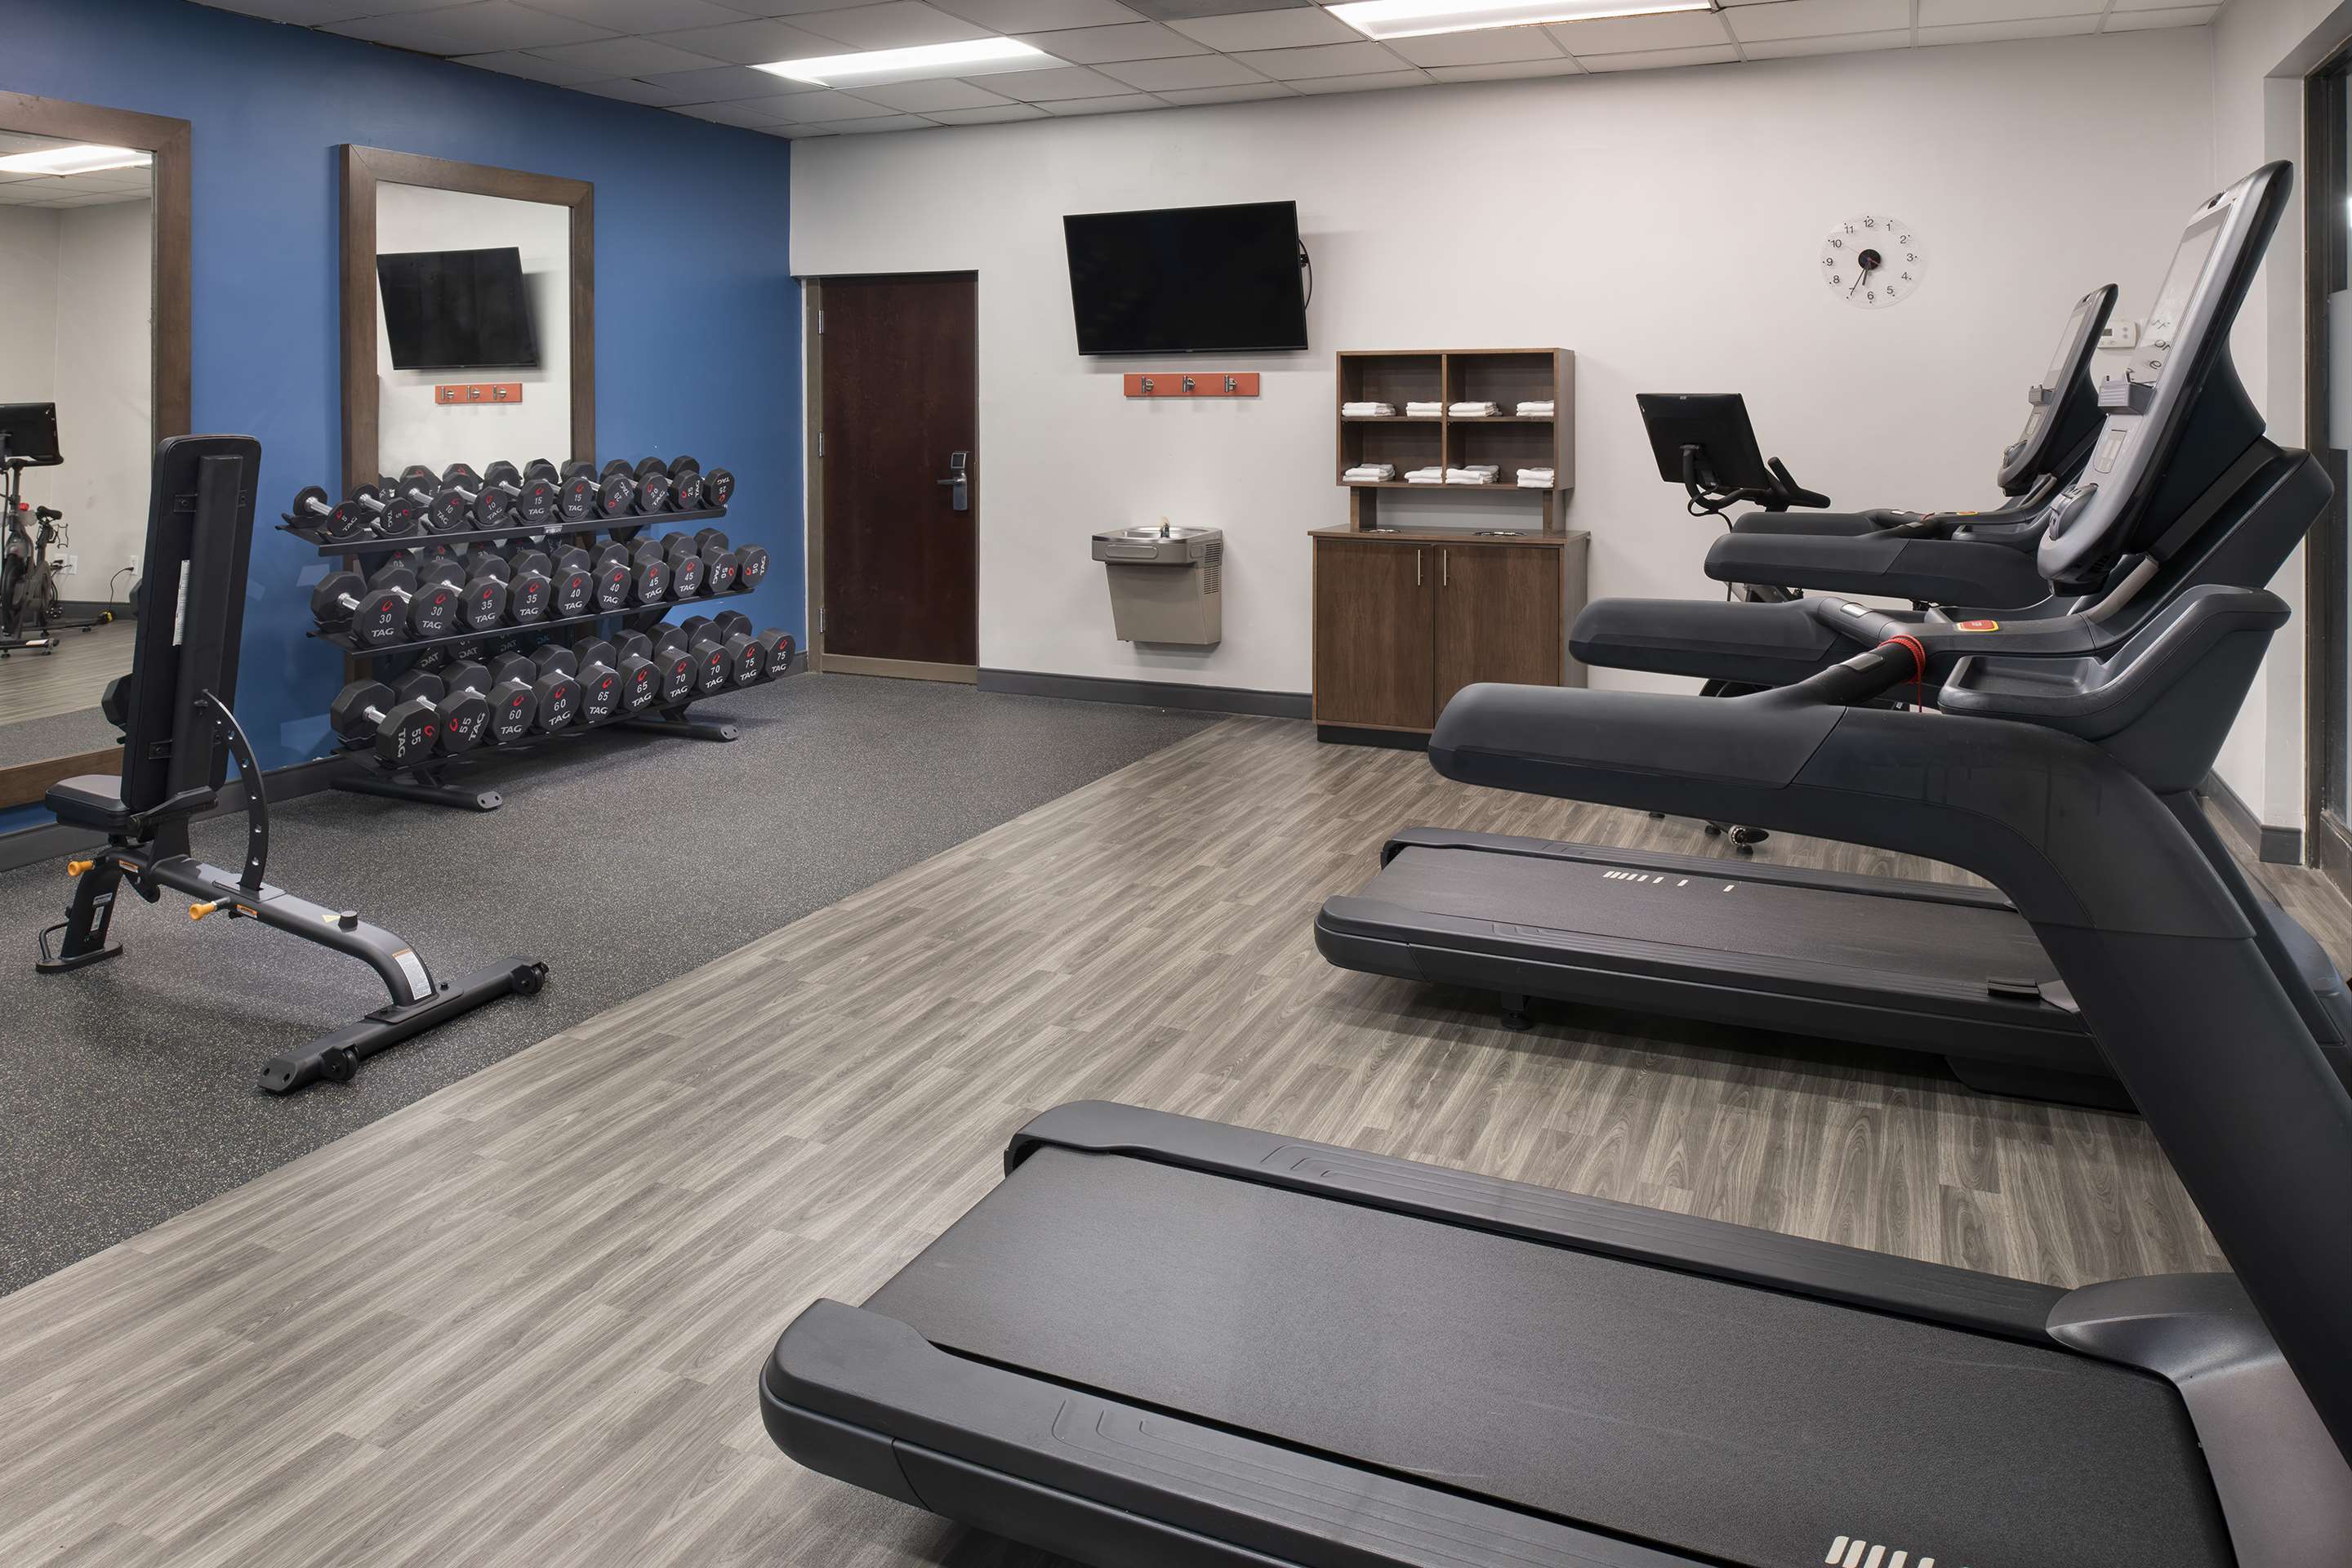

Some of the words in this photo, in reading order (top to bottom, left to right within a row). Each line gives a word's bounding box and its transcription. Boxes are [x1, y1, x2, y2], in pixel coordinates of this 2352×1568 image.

[1863, 218, 1874, 228] 12
[1886, 223, 1891, 231] 1
[1844, 225, 1853, 234] 11
[1831, 238, 1842, 248] 10
[1900, 234, 1907, 244] 2
[1826, 257, 1833, 266] 9
[1906, 252, 1913, 261] 3
[1833, 274, 1840, 284] 8
[1900, 271, 1909, 280] 4
[1886, 285, 1894, 294] 5
[1867, 291, 1874, 300] 6
[717, 477, 731, 485] TAG
[619, 482, 630, 497] TAG
[650, 488, 658, 498] 20
[687, 487, 694, 496] 25
[718, 486, 727, 494] 25
[534, 497, 542, 505] 15
[574, 493, 582, 502] 15
[613, 492, 622, 502] 20
[652, 490, 666, 506] TAG
[446, 504, 454, 514] 10
[488, 501, 496, 511] 10
[437, 510, 449, 524] TAG
[488, 507, 502, 520] TAG
[342, 516, 358, 532] TAG
[721, 568, 728, 579] 50
[752, 563, 759, 574] 50
[684, 572, 694, 581] 45
[712, 564, 721, 585] TAG
[649, 577, 659, 587] 45
[609, 583, 620, 593] 40
[679, 583, 695, 592] TAG
[570, 588, 581, 599] 40
[644, 587, 662, 599] TAG
[482, 599, 492, 610] 35
[526, 595, 537, 604] 35
[603, 595, 618, 604] TAG
[564, 600, 582, 610] TAG
[430, 606, 443, 616] 30
[519, 607, 539, 616] TAG
[379, 613, 392, 624] 30
[475, 612, 496, 623] TAG
[421, 620, 443, 630] TAG
[371, 627, 394, 637] TAG
[777, 651, 786, 661] 75
[745, 657, 755, 668] 75
[710, 665, 720, 675] 70
[771, 663, 786, 673] TAG
[675, 673, 686, 684] 70
[740, 670, 757, 682] TAG
[636, 681, 648, 693] 65
[705, 675, 724, 689] TAG
[597, 691, 609, 701] 65
[670, 685, 688, 698] TAG
[632, 693, 652, 707] TAG
[554, 700, 567, 711] 60
[589, 706, 608, 715] TAG
[509, 709, 522, 719] 60
[549, 710, 571, 726] TAG
[459, 718, 471, 733] 55
[468, 712, 485, 742] TAG
[501, 724, 522, 734] TAG
[411, 728, 422, 746] 55
[398, 728, 407, 758] TAG
